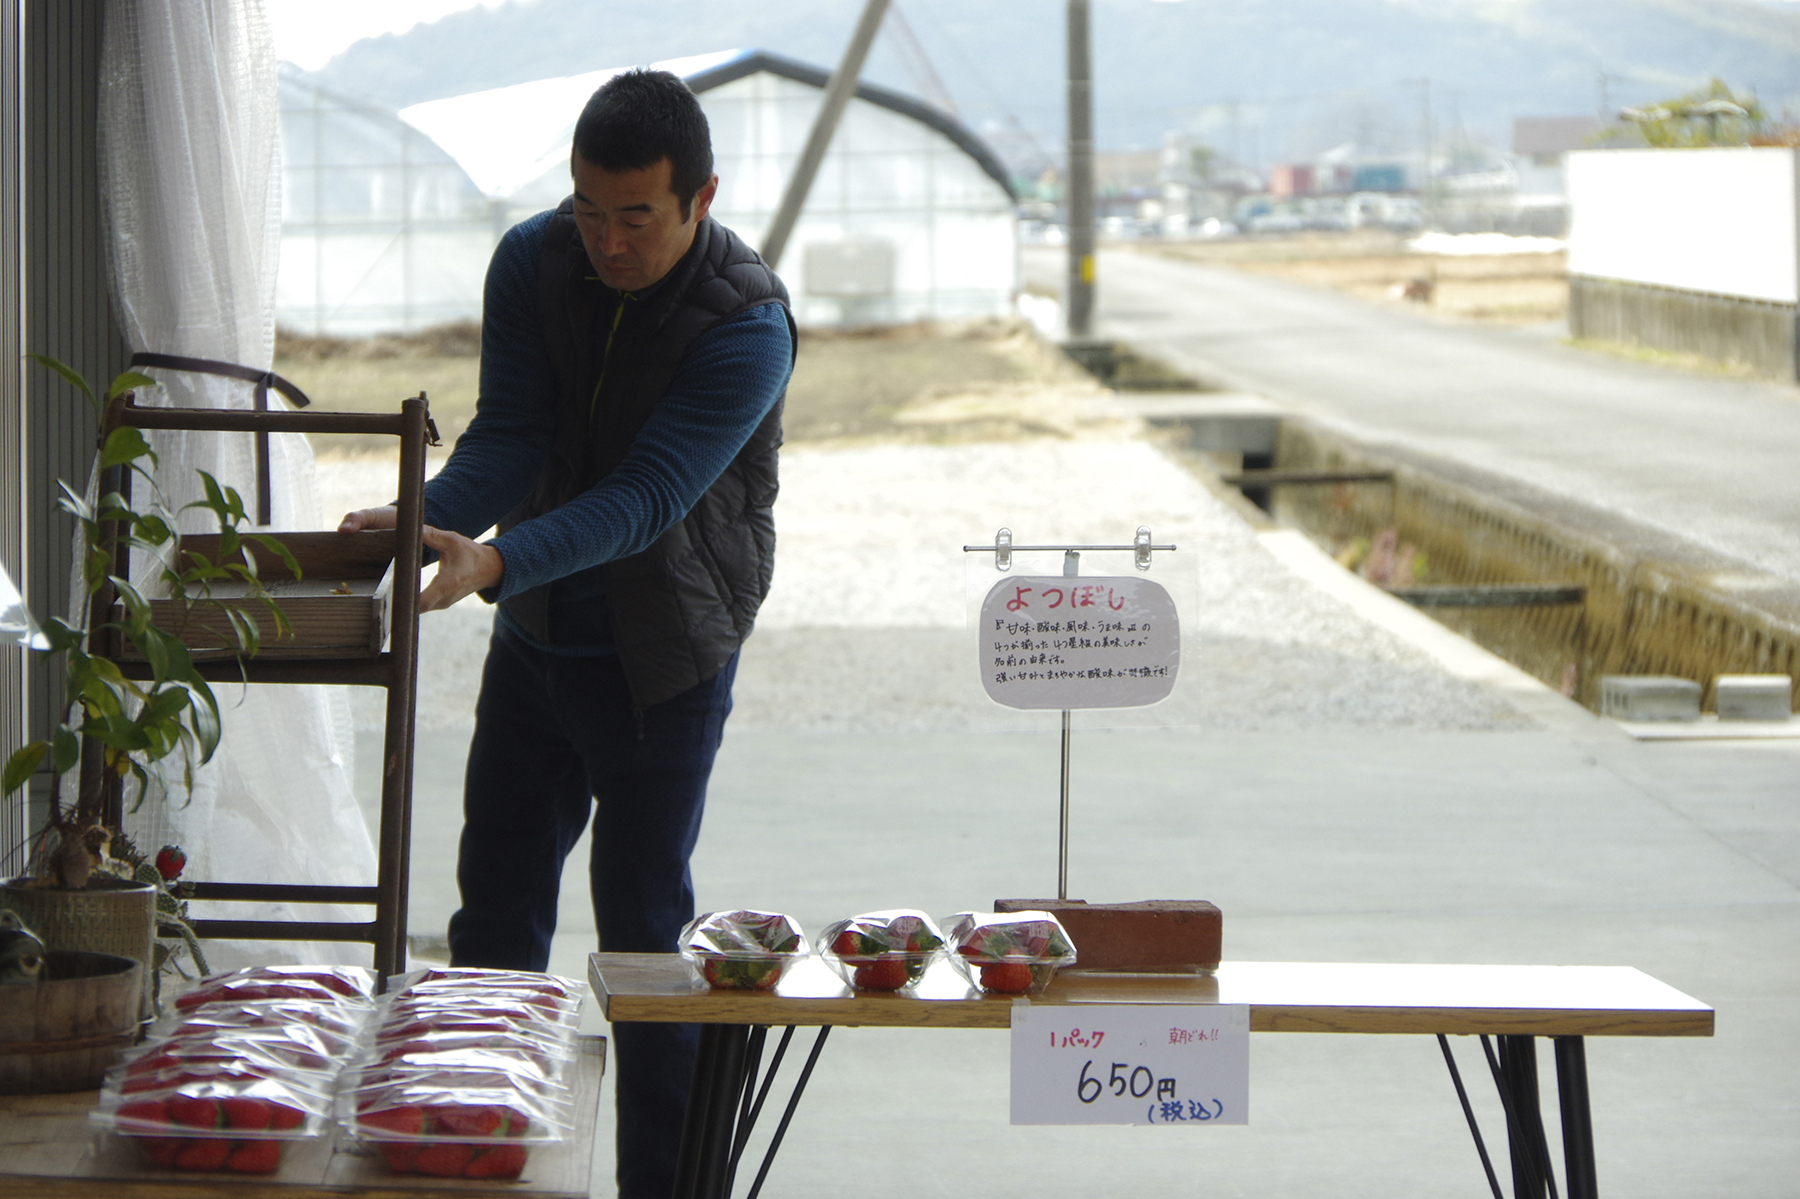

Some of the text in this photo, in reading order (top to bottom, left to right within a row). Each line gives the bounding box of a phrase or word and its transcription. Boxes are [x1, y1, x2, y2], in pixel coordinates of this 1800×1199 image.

[1006, 586, 1125, 612] よつぼし
[1050, 1027, 1105, 1049] 1パック
[1077, 1059, 1177, 1105] 650円
[1147, 1098, 1224, 1124] (税込)
